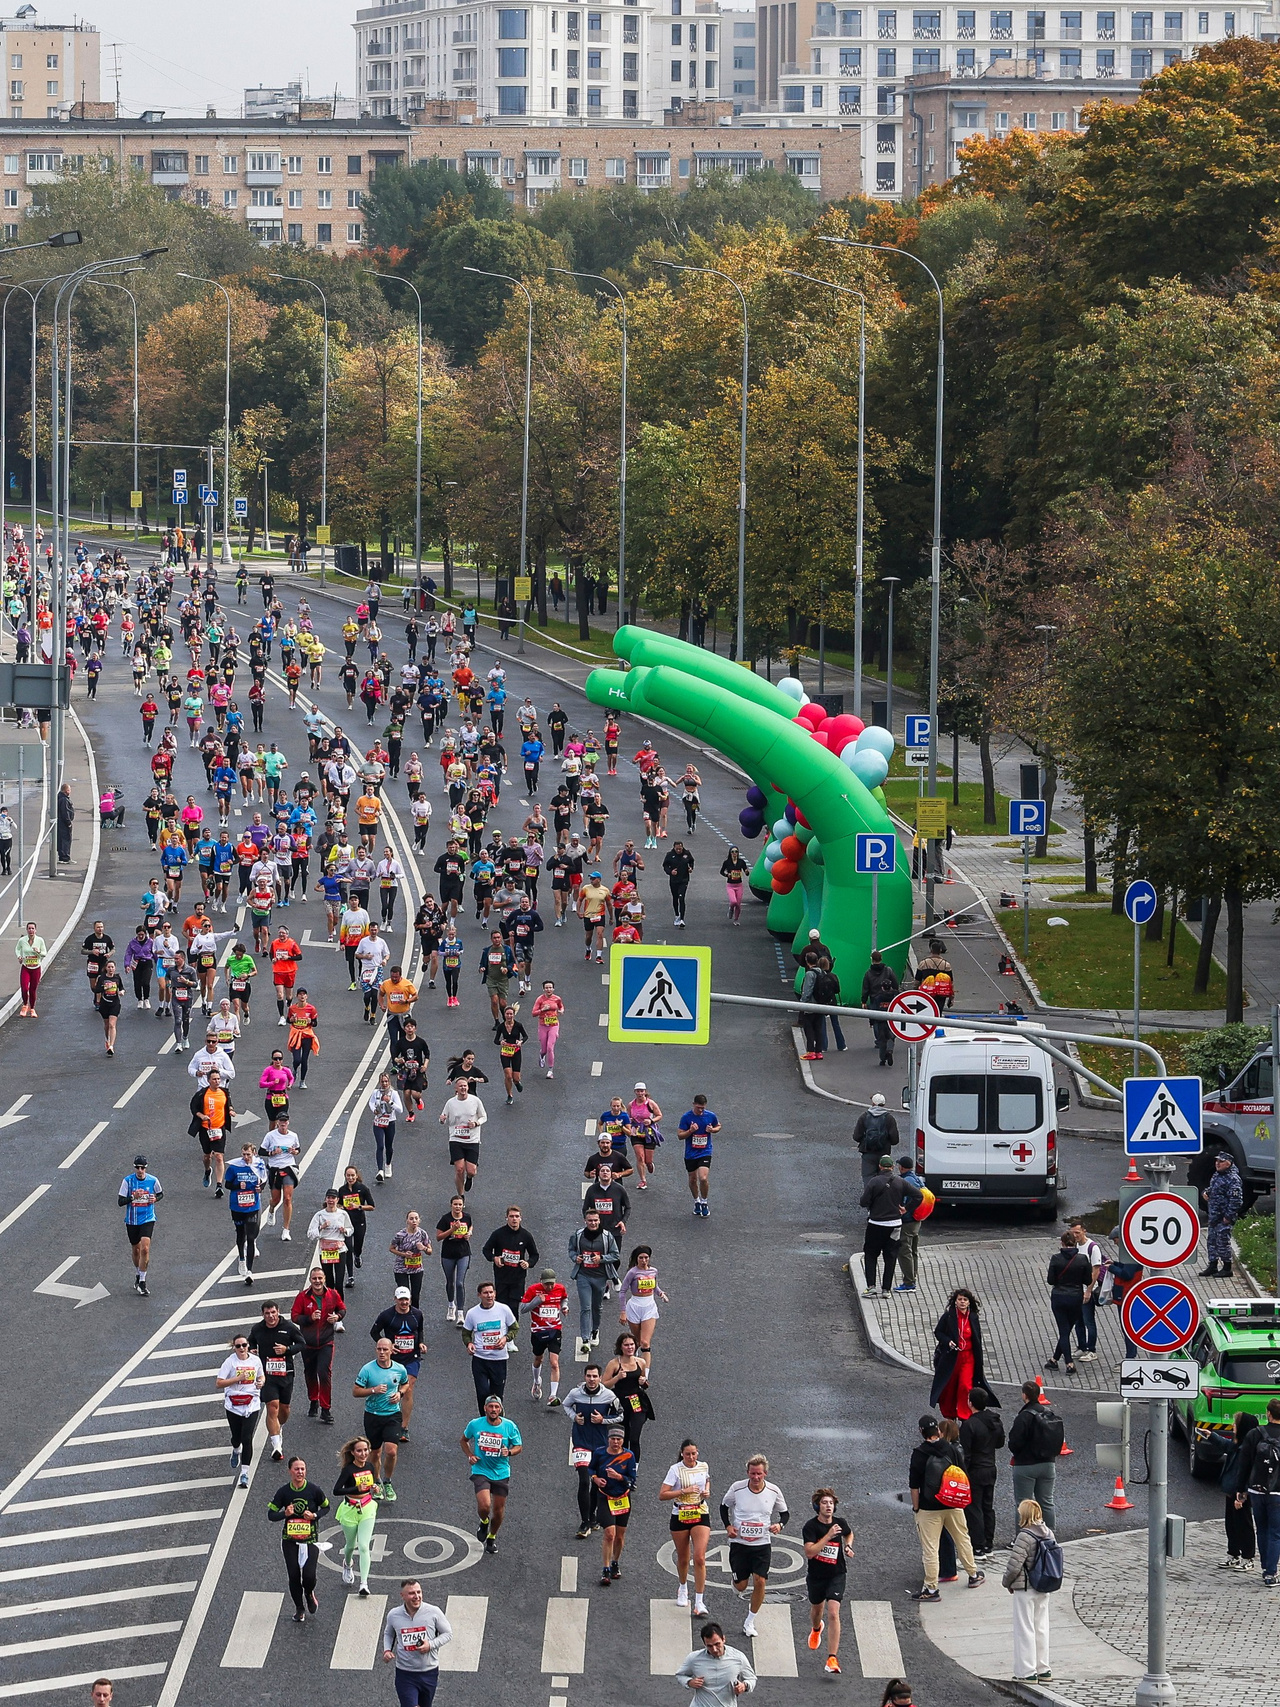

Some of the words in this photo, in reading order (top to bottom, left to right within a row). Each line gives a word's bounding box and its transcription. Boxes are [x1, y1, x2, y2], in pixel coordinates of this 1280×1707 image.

[176, 492, 184, 502] P
[914, 718, 930, 744] P
[1020, 804, 1038, 832] P
[866, 838, 886, 868] P
[1140, 1216, 1182, 1245] 50
[480, 1436, 500, 1446] 26300
[339, 1533, 455, 1564] 40
